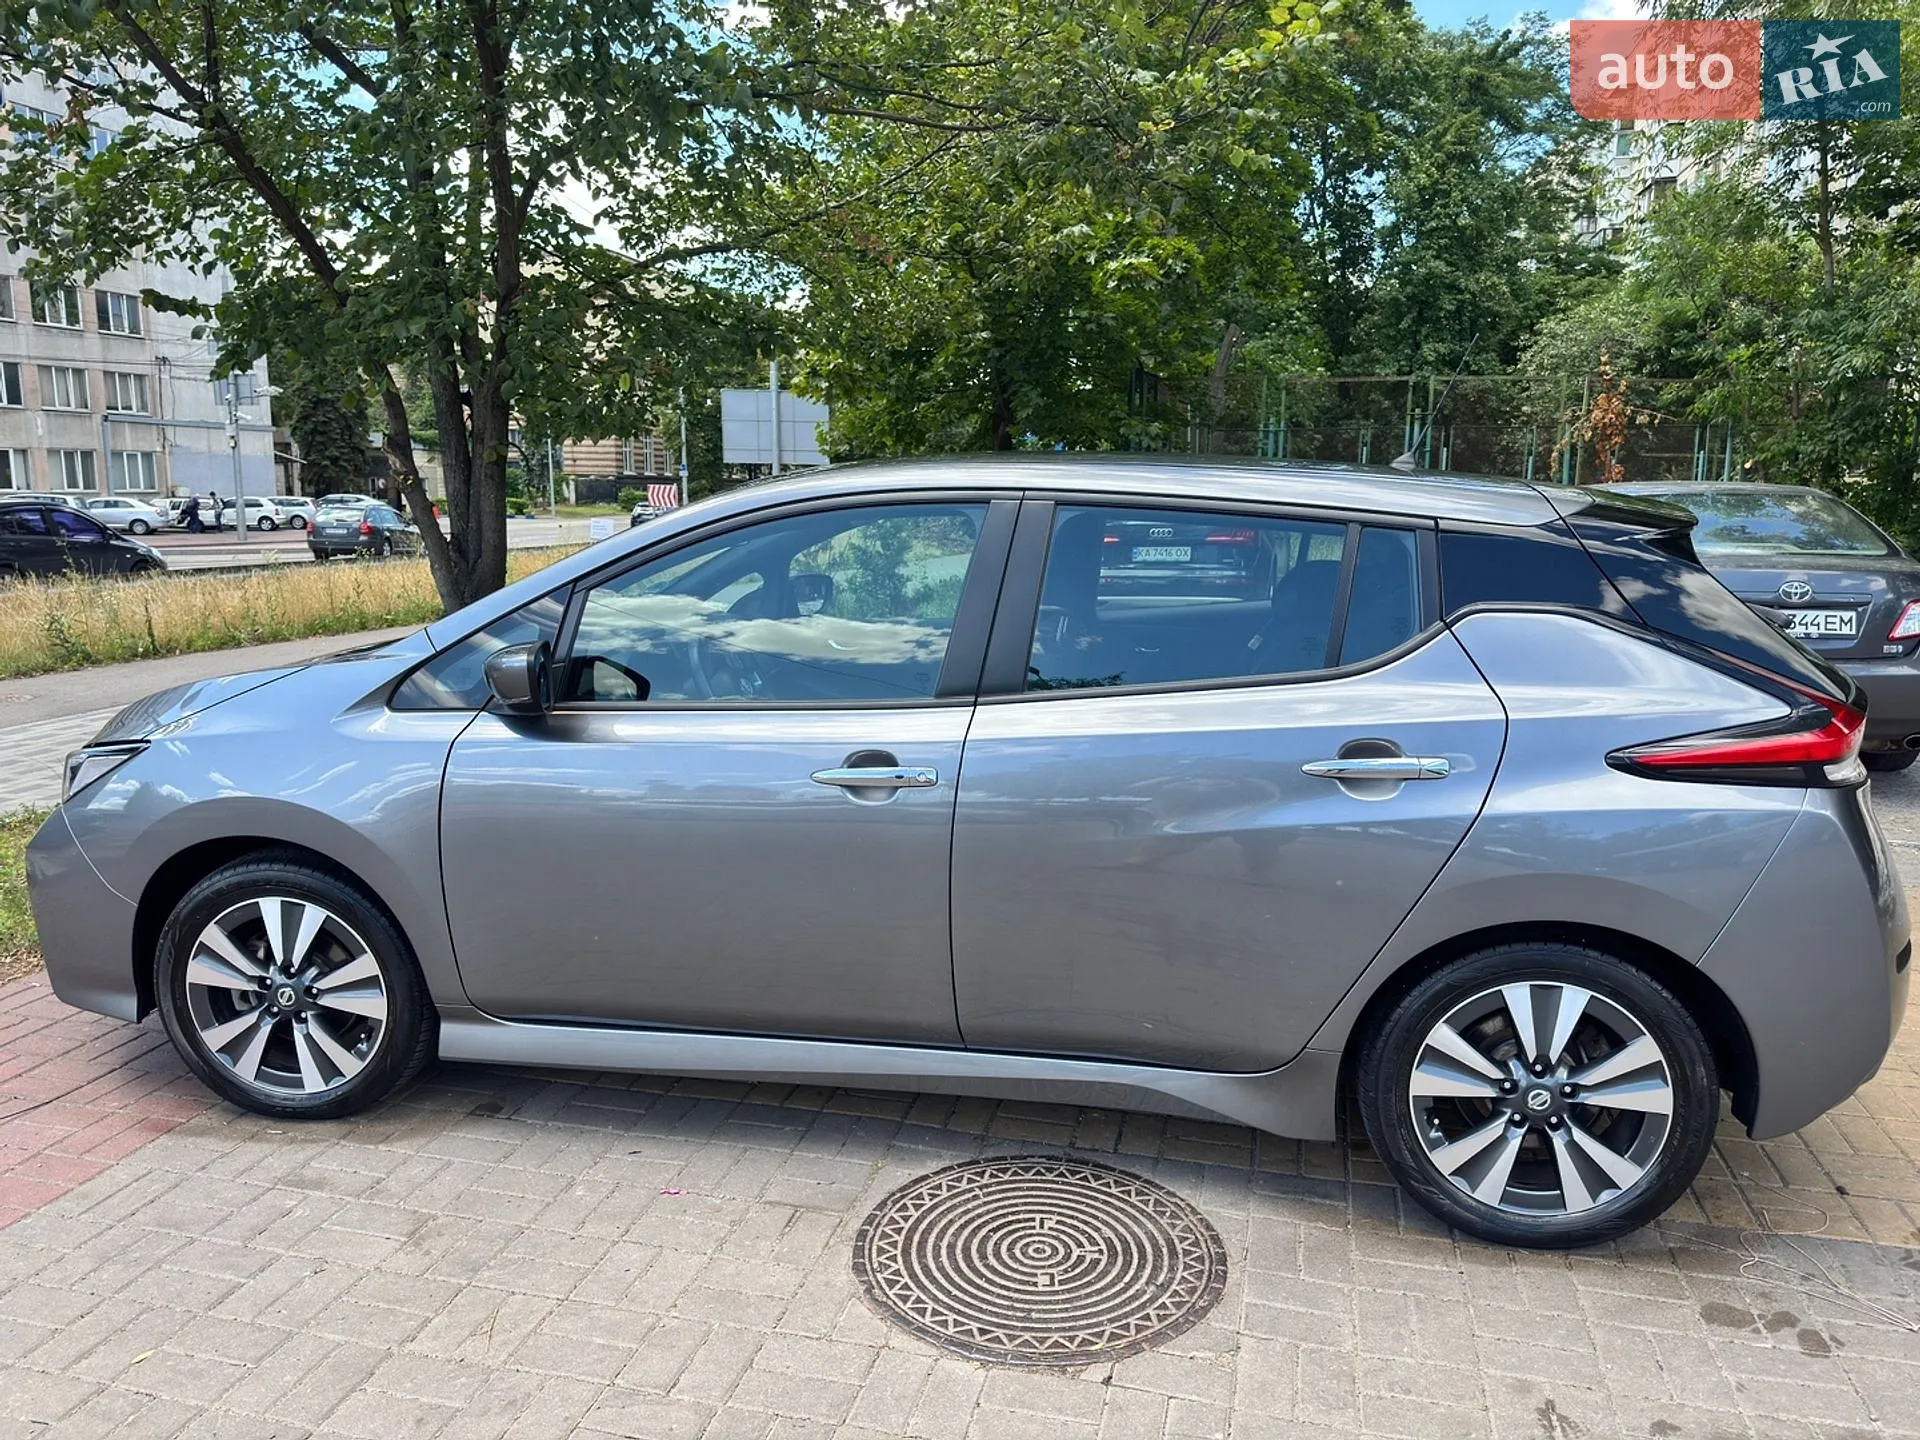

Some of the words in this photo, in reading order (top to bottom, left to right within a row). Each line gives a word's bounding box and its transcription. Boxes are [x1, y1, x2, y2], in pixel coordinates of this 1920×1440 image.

[1137, 548, 1151, 558] KA
[1175, 548, 1189, 558] OX
[1787, 613, 1820, 631] 344
[1824, 614, 1853, 632] EM
